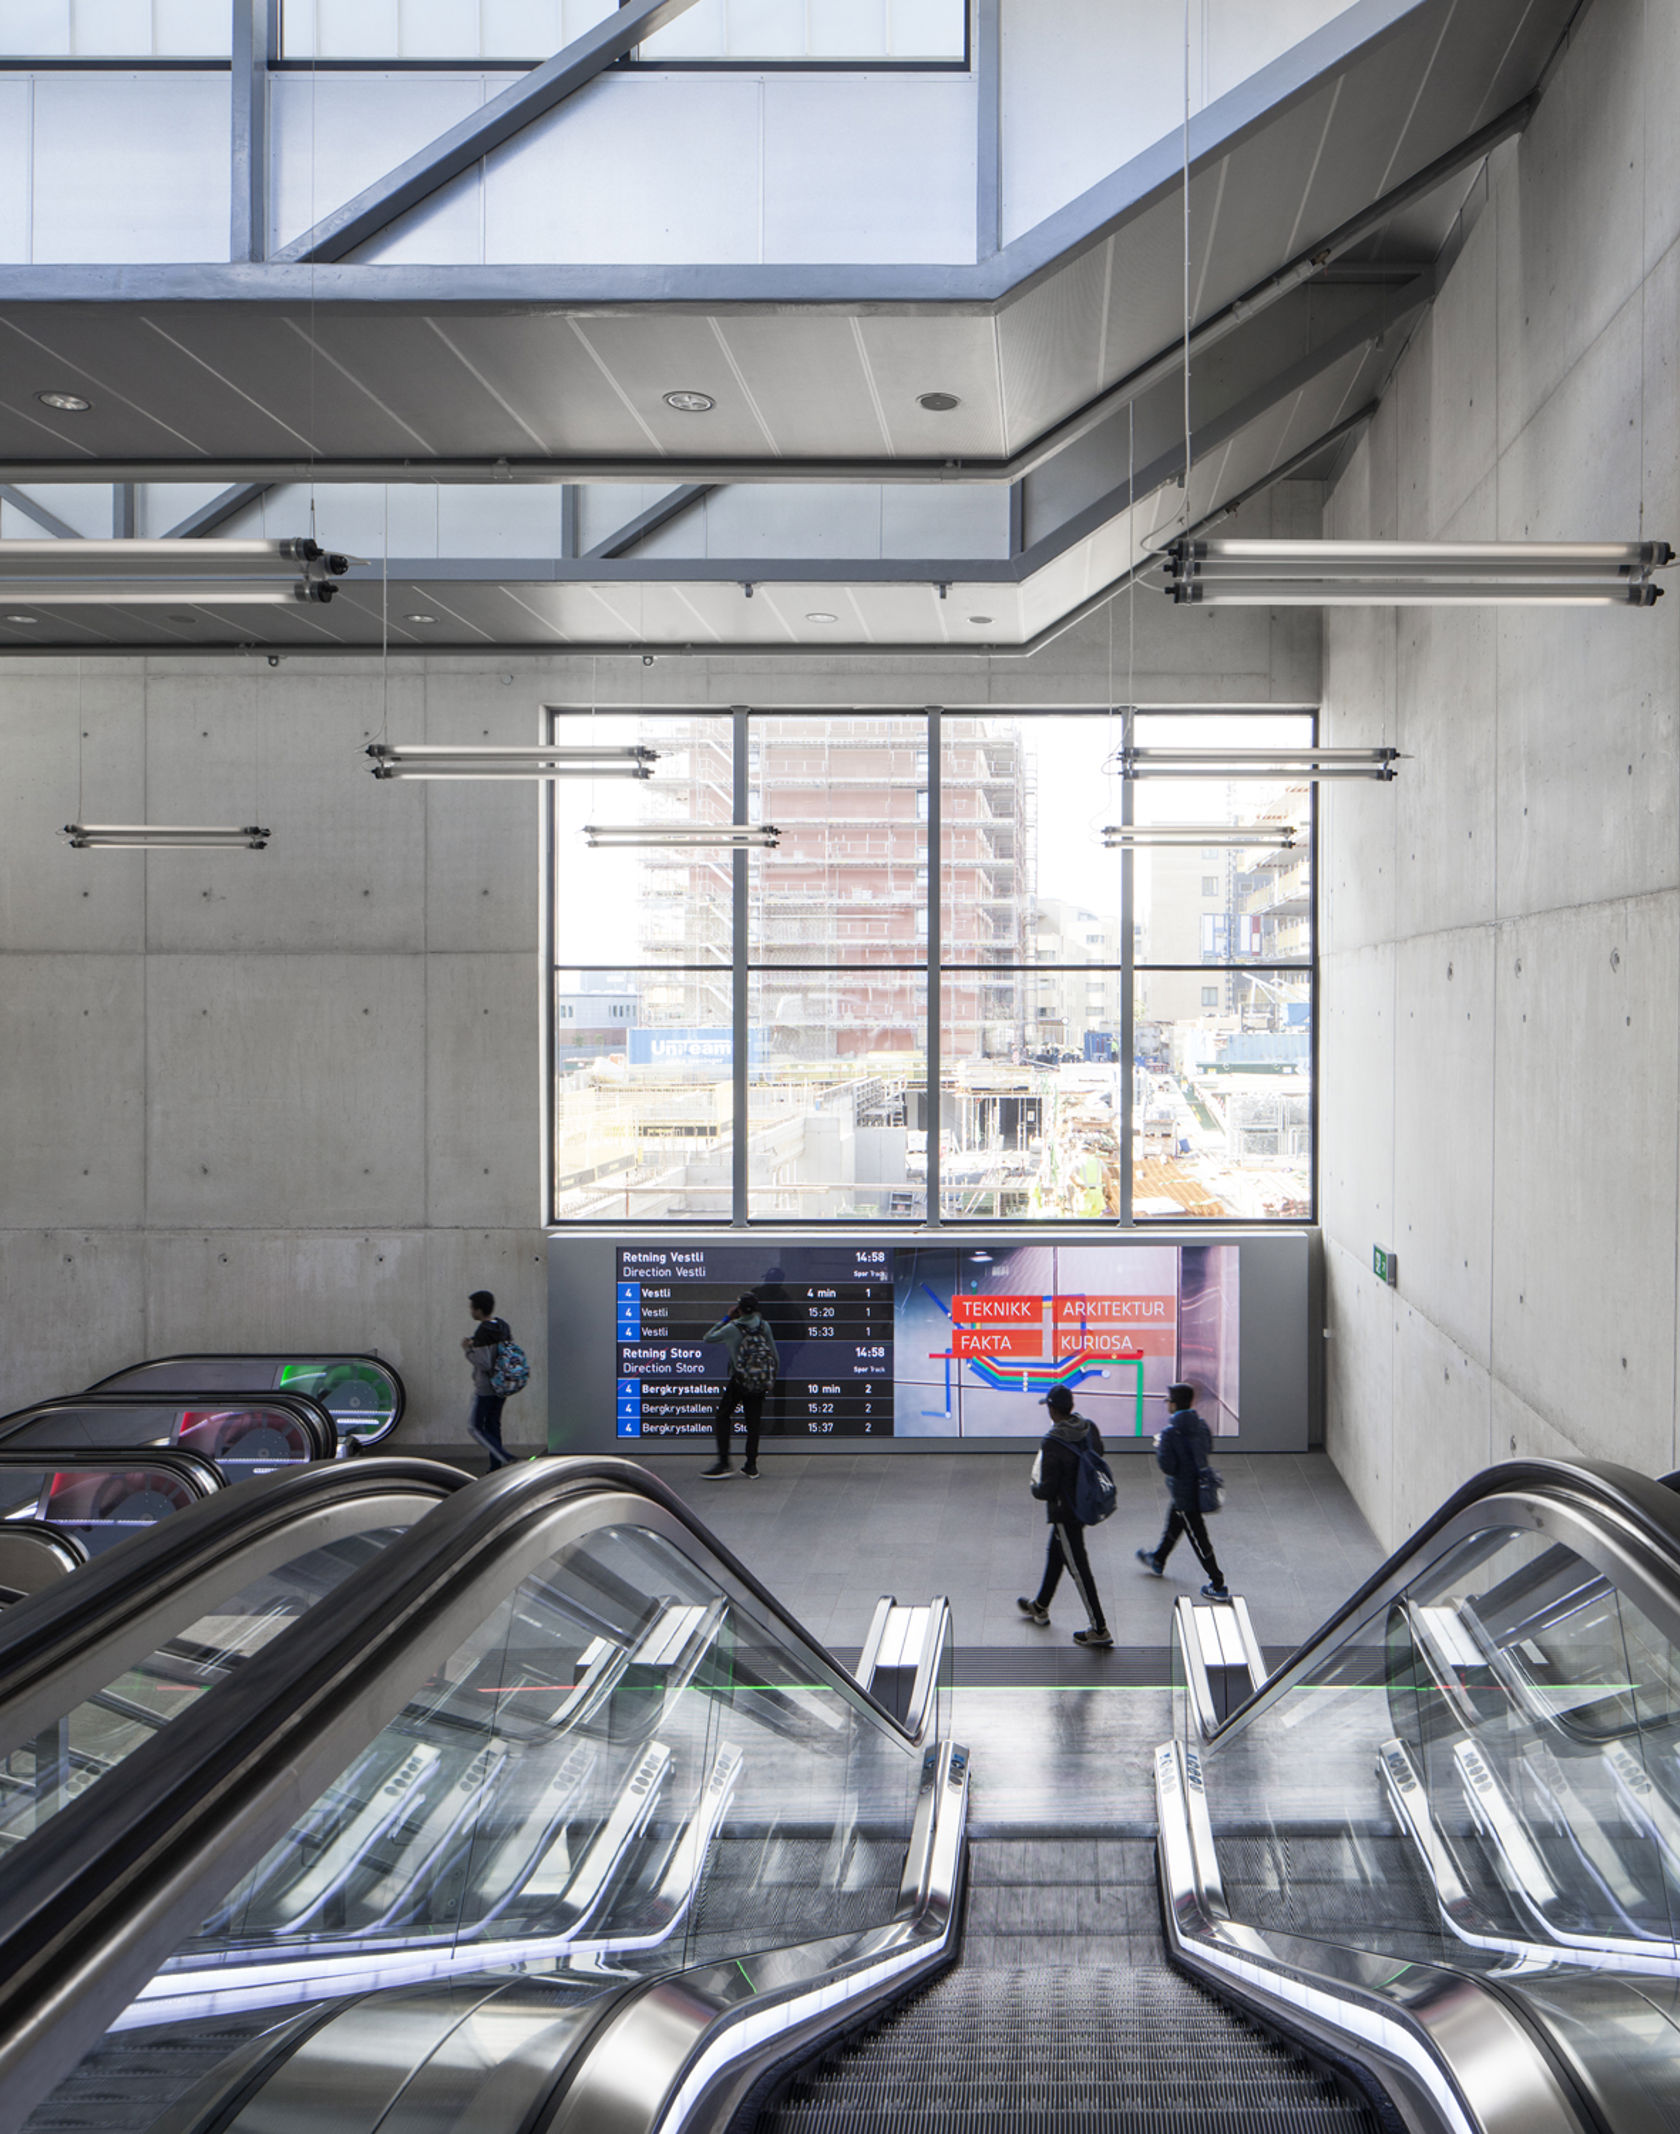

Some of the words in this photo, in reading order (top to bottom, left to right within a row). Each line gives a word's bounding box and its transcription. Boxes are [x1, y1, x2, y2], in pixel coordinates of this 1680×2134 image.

[623, 1252, 666, 1264] Retning
[670, 1252, 704, 1262] Vestli
[855, 1251, 885, 1262] 14:58
[623, 1266, 672, 1277] Direction
[675, 1266, 706, 1277] Vestli
[625, 1288, 632, 1298] 4
[641, 1288, 671, 1298] Vestli
[807, 1288, 814, 1298] 4
[817, 1288, 836, 1298] min
[865, 1288, 871, 1298] 1
[625, 1308, 632, 1318] 4
[641, 1308, 669, 1318] Vestli
[808, 1308, 834, 1318] 15:20
[865, 1308, 871, 1318] 1
[962, 1302, 1031, 1316] TEKNIKK
[1063, 1301, 1165, 1316] ARKITEKTUR
[625, 1327, 632, 1337] 4
[641, 1327, 669, 1337] Vestli
[808, 1327, 834, 1337] 15:33
[865, 1327, 871, 1337] 1
[961, 1336, 1012, 1350] FAKTA
[1061, 1335, 1133, 1350] KURIOSA
[623, 1348, 666, 1360] Retning
[670, 1348, 702, 1358] Storo
[855, 1347, 885, 1358] 14:58
[623, 1362, 672, 1373] Direction
[675, 1362, 705, 1373] Storo
[625, 1384, 632, 1394] 4
[641, 1384, 720, 1396] Bergkrystallen
[808, 1384, 819, 1394] 10
[822, 1384, 841, 1394] min
[865, 1384, 872, 1394] 2
[625, 1403, 632, 1413] 4
[641, 1403, 713, 1415] Bergkrystallen
[808, 1403, 834, 1413] 15:22
[865, 1403, 872, 1413] 2
[625, 1422, 632, 1432] 4
[641, 1422, 713, 1434] Bergkrystallen
[808, 1422, 834, 1432] 15:37
[865, 1422, 872, 1432] 2
